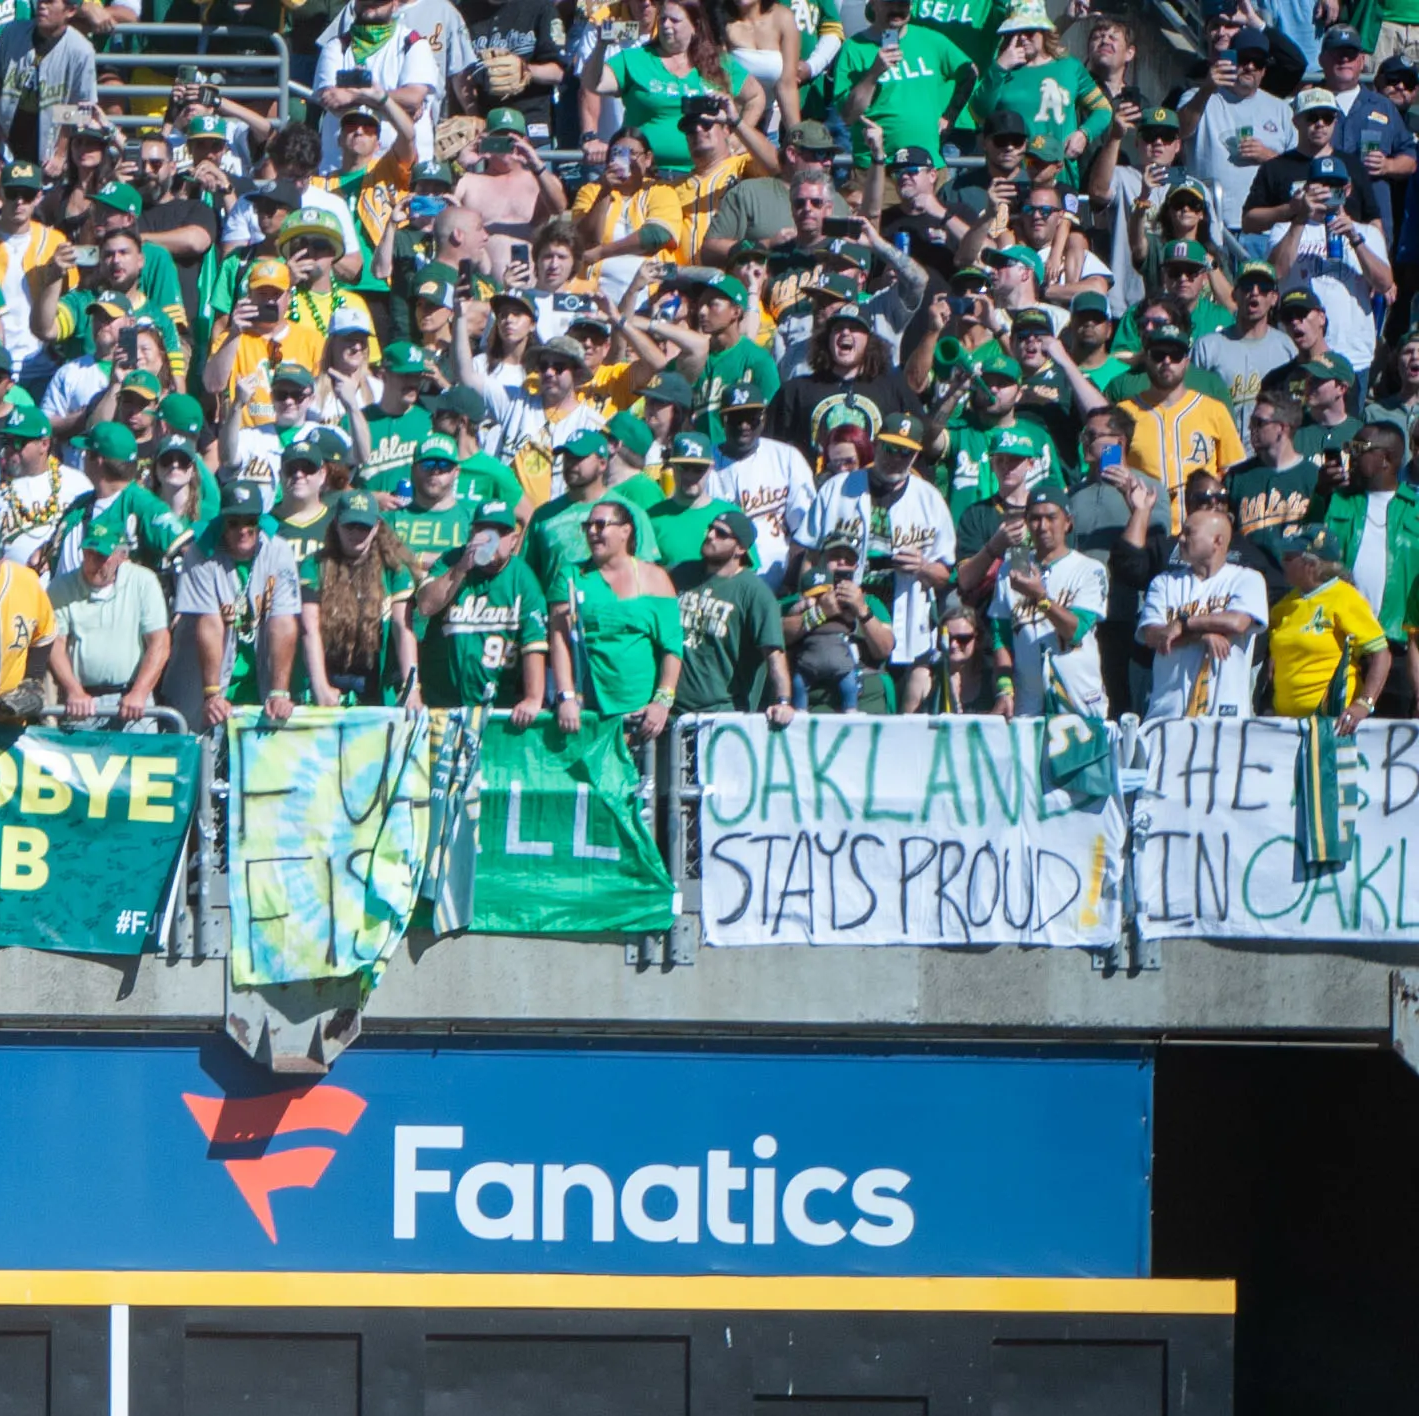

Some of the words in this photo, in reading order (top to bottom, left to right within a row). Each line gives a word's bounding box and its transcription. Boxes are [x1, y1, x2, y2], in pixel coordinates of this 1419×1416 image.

[919, 0, 974, 23] SELL
[877, 58, 934, 82] SELL
[1034, 77, 1071, 126] A's
[449, 476, 482, 500] LL
[740, 485, 790, 512] letics
[448, 594, 521, 624] akland
[1145, 718, 1281, 815] THE
[505, 779, 620, 861] LL
[709, 831, 886, 932] STAYS
[1147, 831, 1230, 922] IN
[393, 1125, 914, 1246] Fanatics
